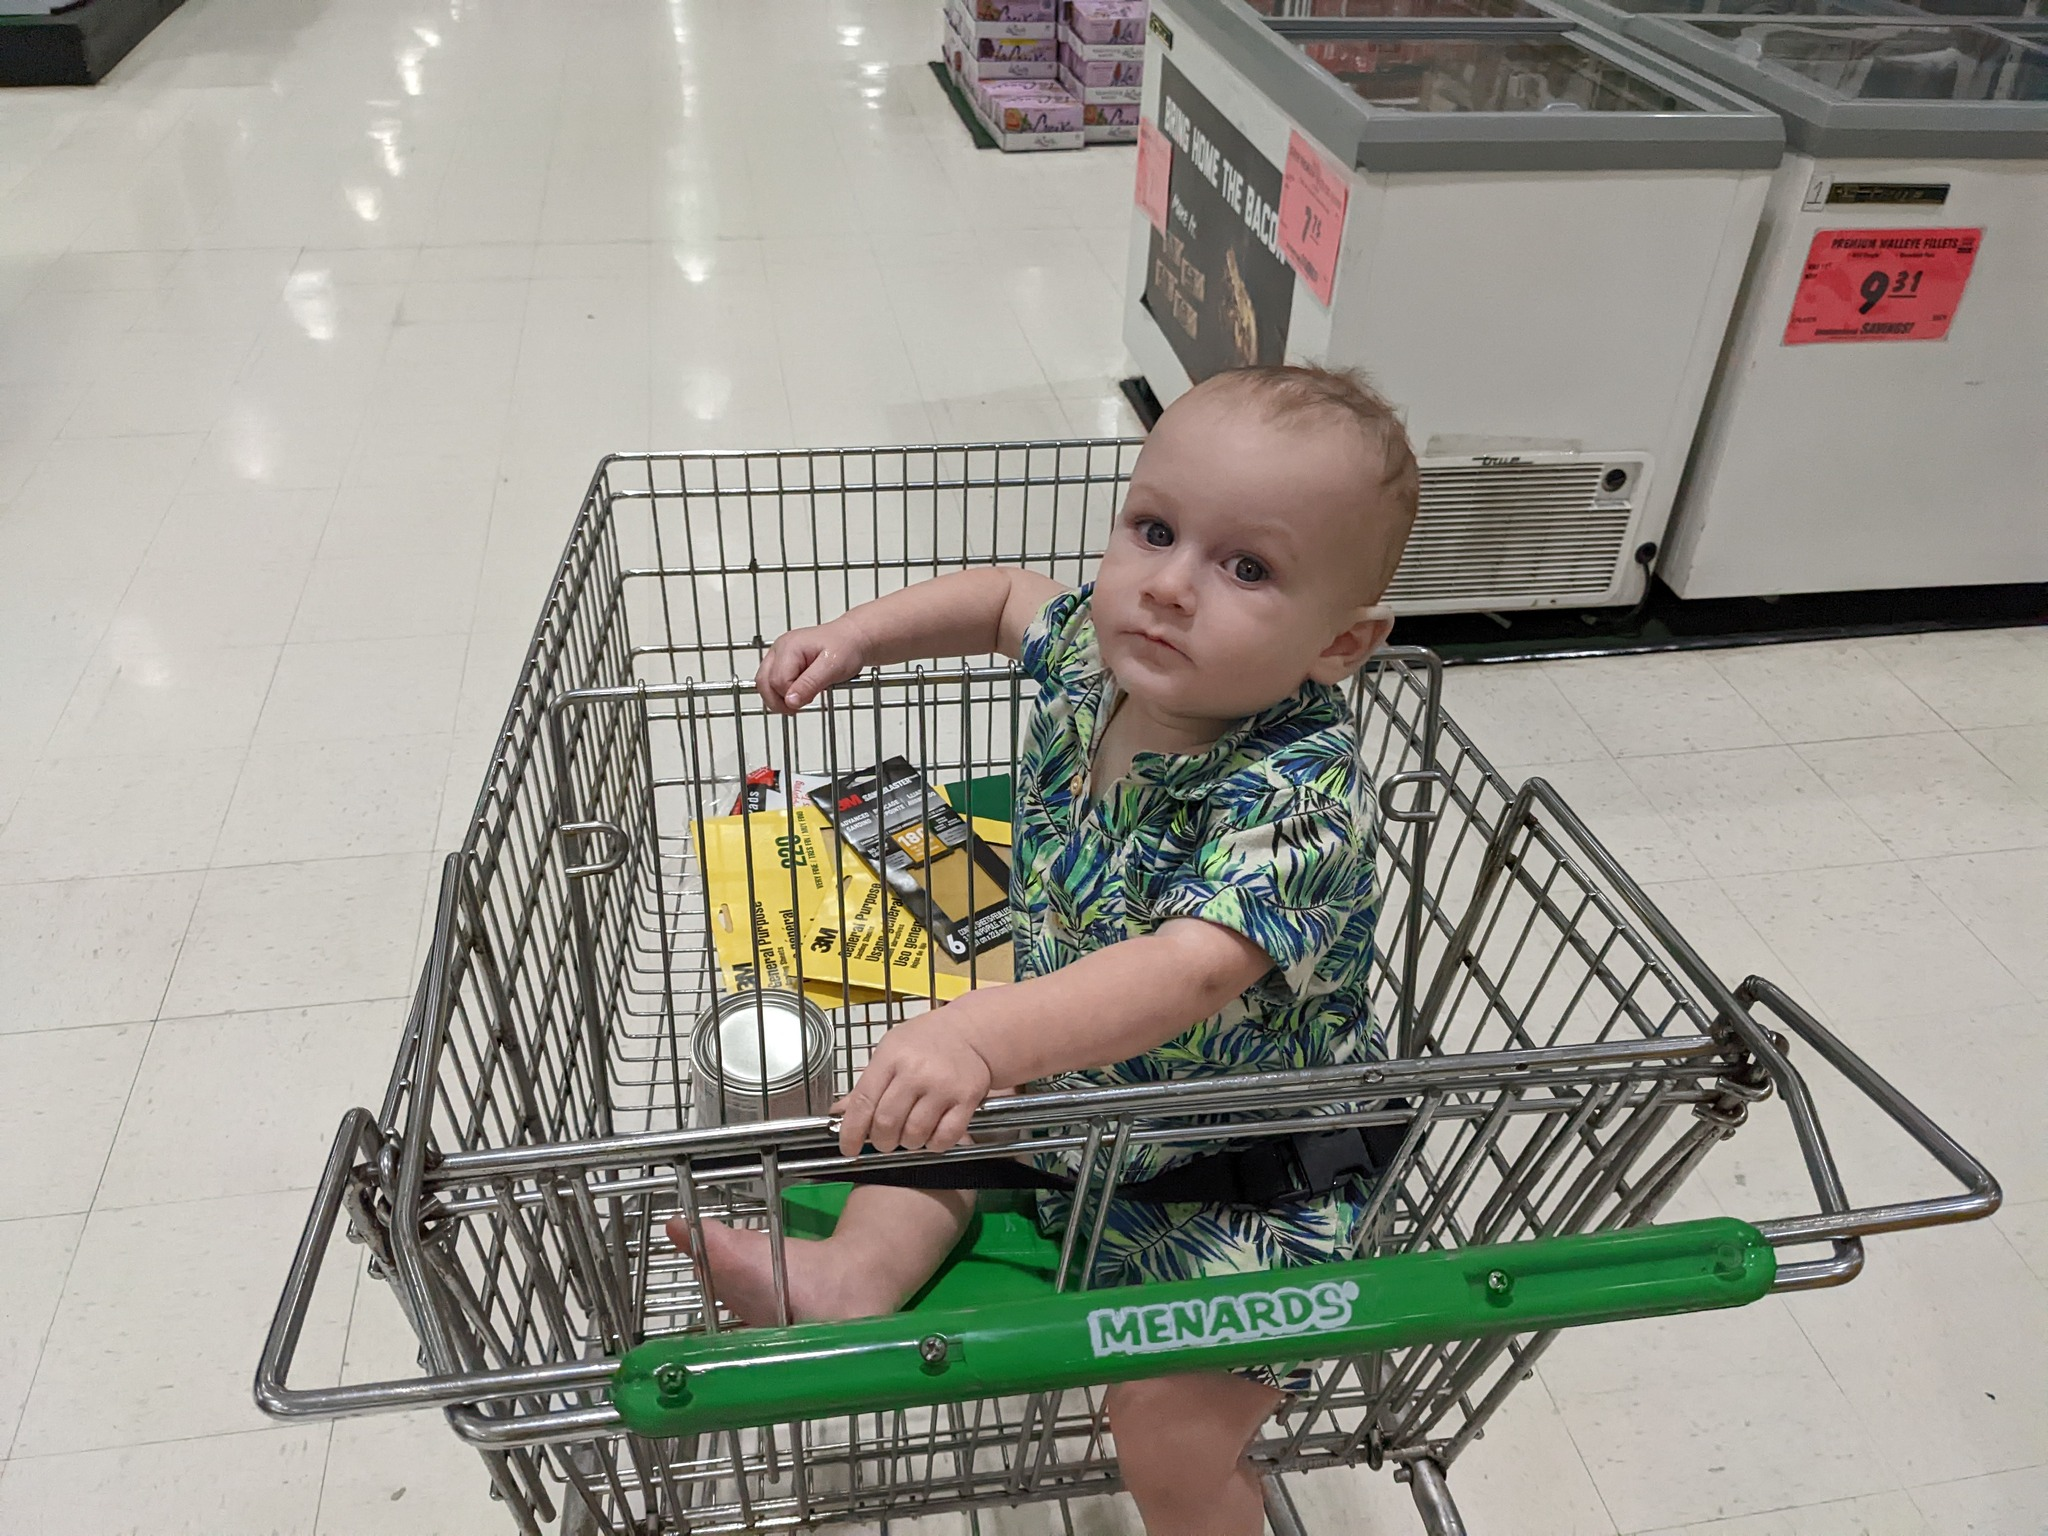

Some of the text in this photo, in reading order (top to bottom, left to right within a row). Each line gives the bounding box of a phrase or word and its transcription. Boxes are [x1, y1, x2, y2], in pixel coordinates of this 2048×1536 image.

[1164, 95, 1286, 265] BRING HOME THE BACO
[1831, 238, 1877, 249] PREMIUM
[1879, 238, 1922, 249] WALLEYE
[1923, 238, 1958, 249] FILLETS
[1858, 270, 1923, 315] 9 31
[837, 778, 912, 811] 3M SANBLASTER
[840, 812, 870, 828] ADVANCED
[775, 834, 807, 869] 220
[814, 875, 824, 889] VERY
[854, 883, 881, 921] Purpose
[811, 927, 838, 953] 3M
[893, 920, 922, 967] Uso gener
[946, 934, 966, 954] 6
[732, 962, 755, 991] 3M
[759, 948, 782, 988] General
[1088, 1282, 1355, 1357] MENARDS
